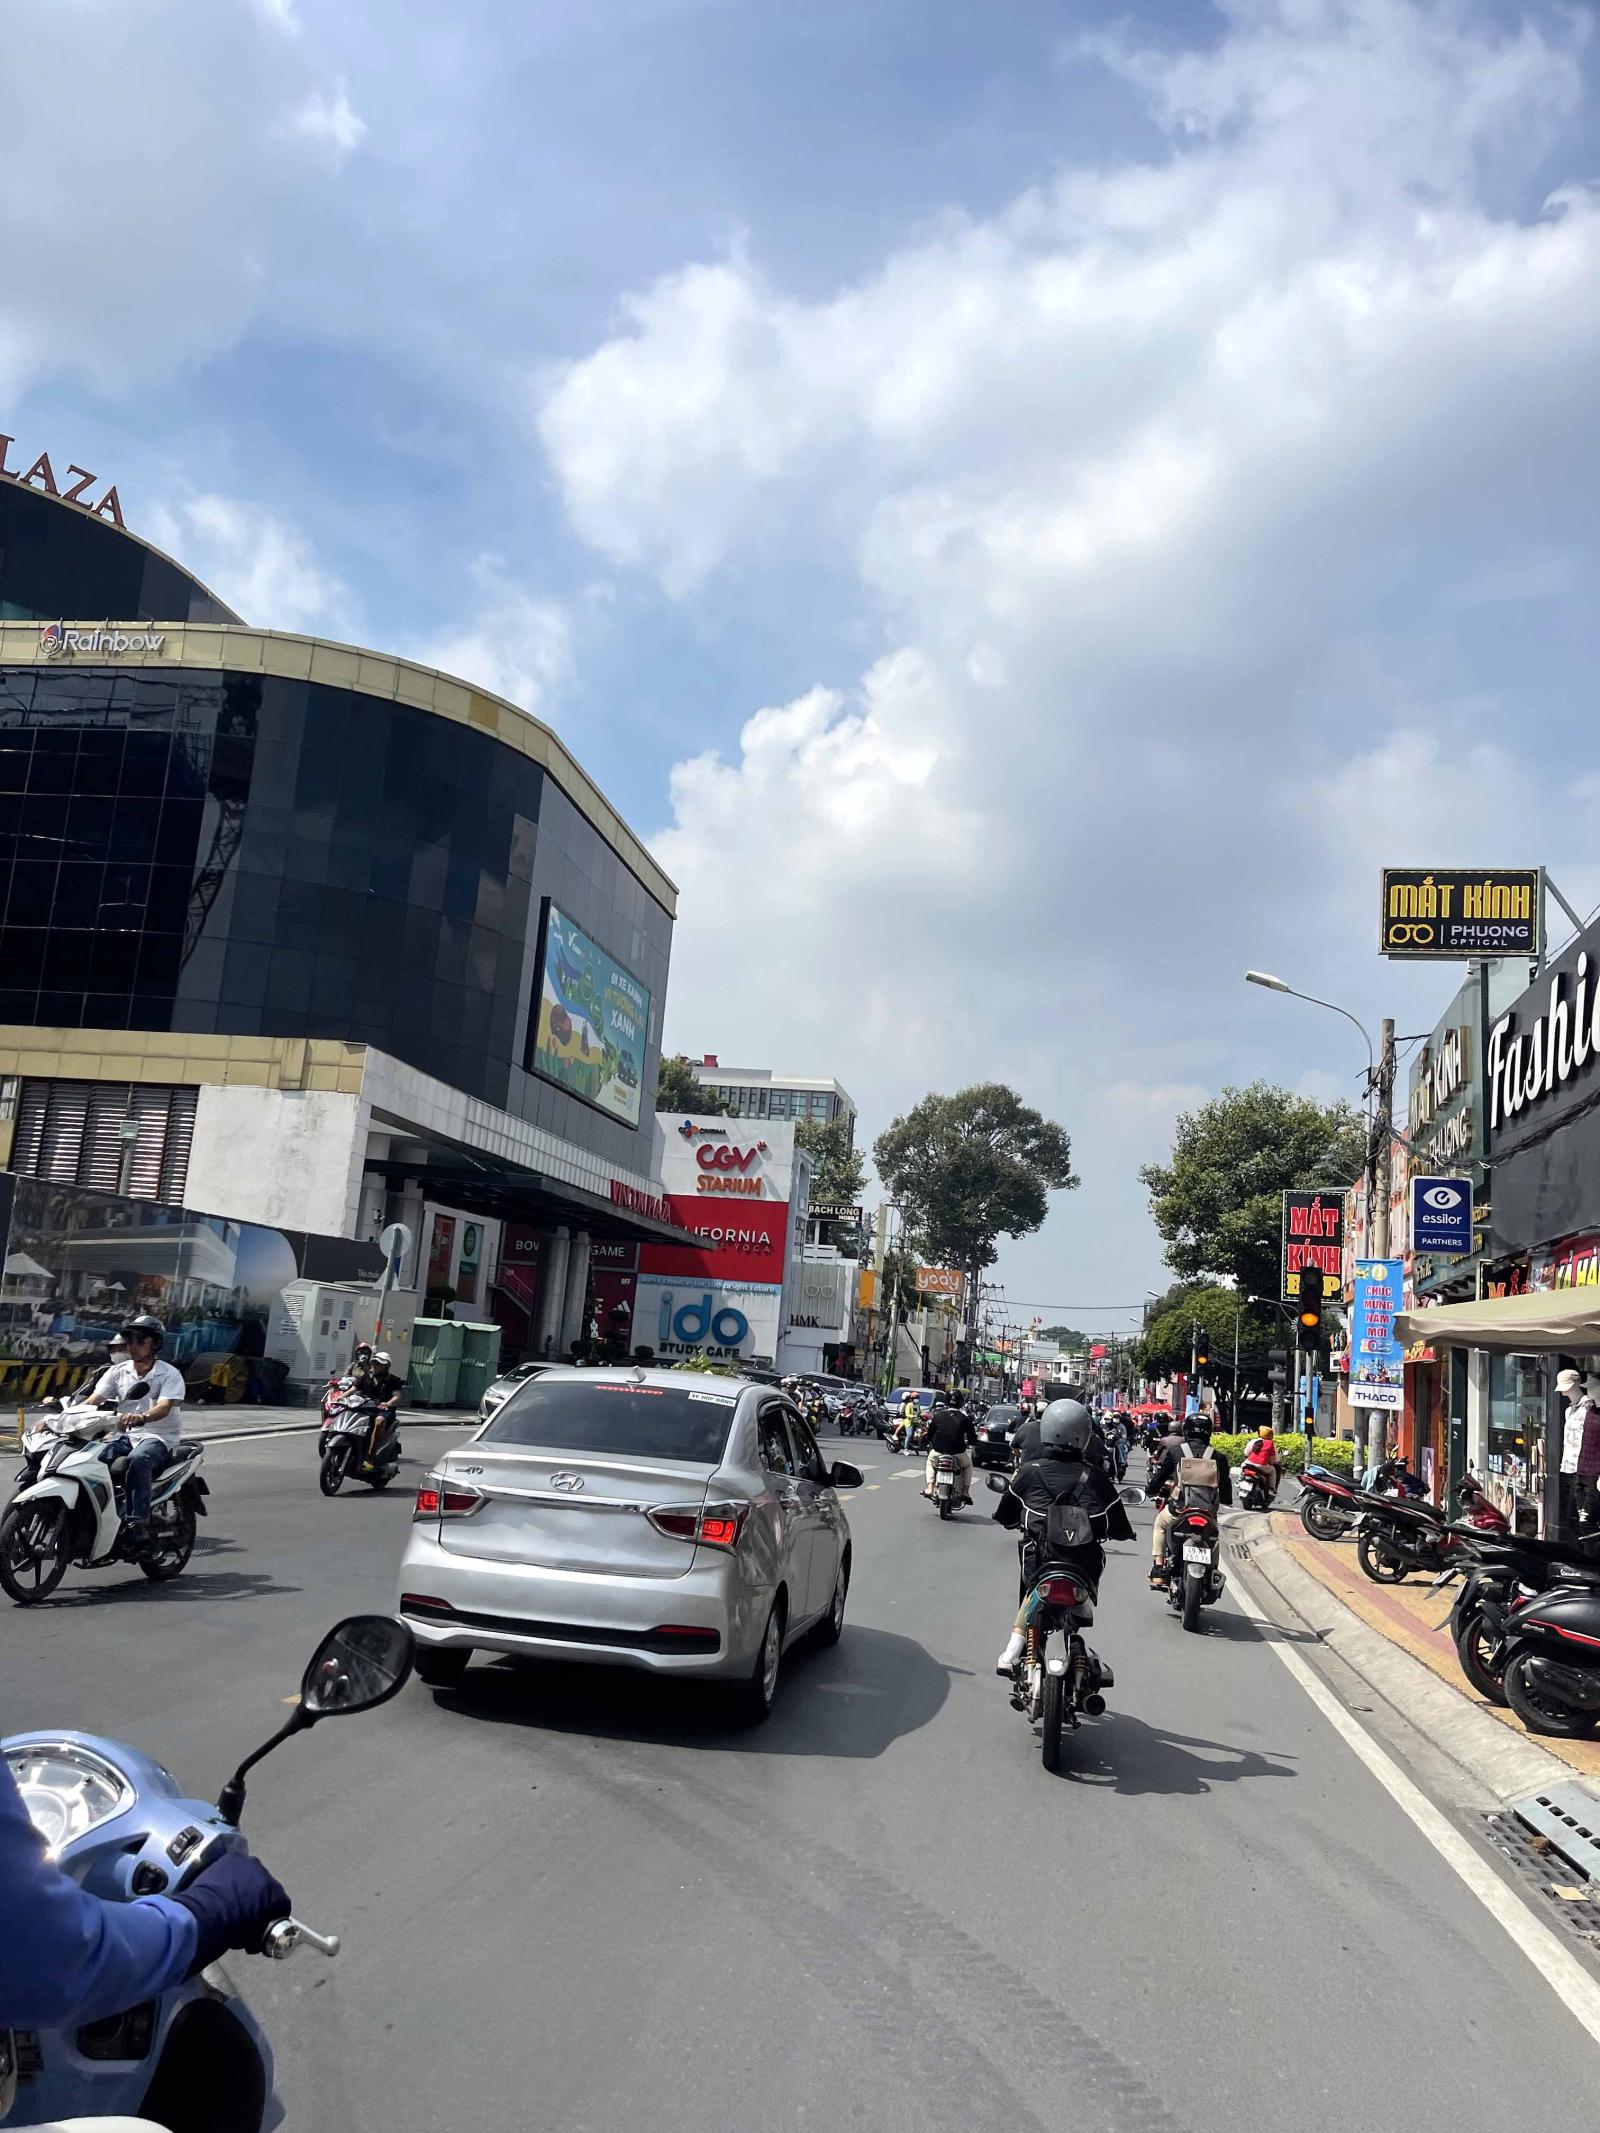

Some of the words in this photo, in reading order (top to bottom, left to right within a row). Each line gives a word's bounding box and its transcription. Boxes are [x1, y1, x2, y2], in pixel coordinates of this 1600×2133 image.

[63, 629, 165, 652] Rainbow
[1389, 876, 1455, 918] MẮT
[1463, 880, 1530, 919] KÍNH
[1450, 925, 1529, 937] PHUONG
[610, 1009, 635, 1041] XANH
[696, 1144, 757, 1173] CGV
[696, 1174, 762, 1197] STARIUM
[834, 1207, 860, 1216] LONG
[1289, 1196, 1339, 1237] MẮT
[1422, 1213, 1463, 1225] essilor
[591, 1245, 625, 1257] GAME
[1421, 1237, 1463, 1246] PARTNERS
[1286, 1238, 1341, 1275] KÍNH
[918, 1272, 961, 1291] yody
[1286, 1273, 1341, 1297] BP
[658, 1290, 749, 1346] ido
[790, 1314, 820, 1328] HMK
[659, 1342, 703, 1355] STUDY
[706, 1346, 740, 1358] CAFE
[1355, 1391, 1397, 1403] THACO
